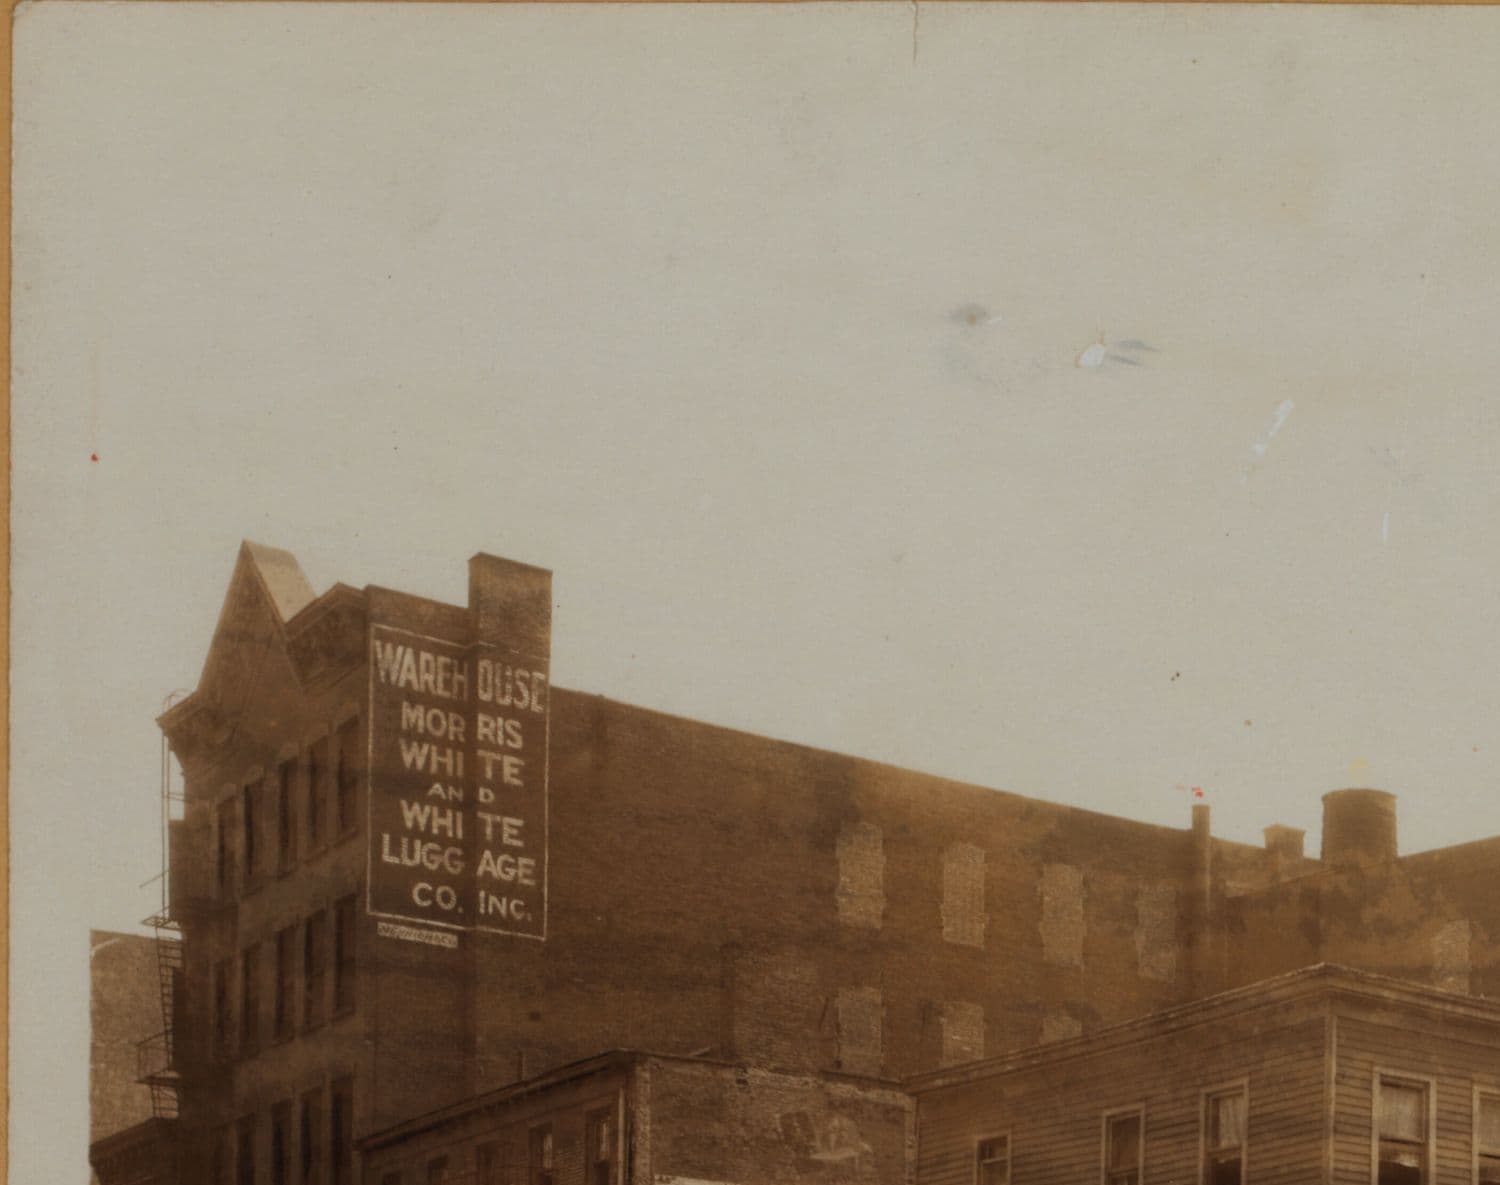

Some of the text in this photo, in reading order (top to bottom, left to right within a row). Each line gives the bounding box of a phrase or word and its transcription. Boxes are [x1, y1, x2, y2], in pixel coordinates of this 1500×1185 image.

[376, 640, 545, 713] WAREHOUSE
[402, 701, 522, 749] MORRIS
[399, 739, 524, 786] WHITE
[427, 783, 495, 802] AND
[400, 799, 524, 847] WHITE
[382, 834, 536, 886] LUGGAGE
[412, 882, 531, 921] CO. INC.
